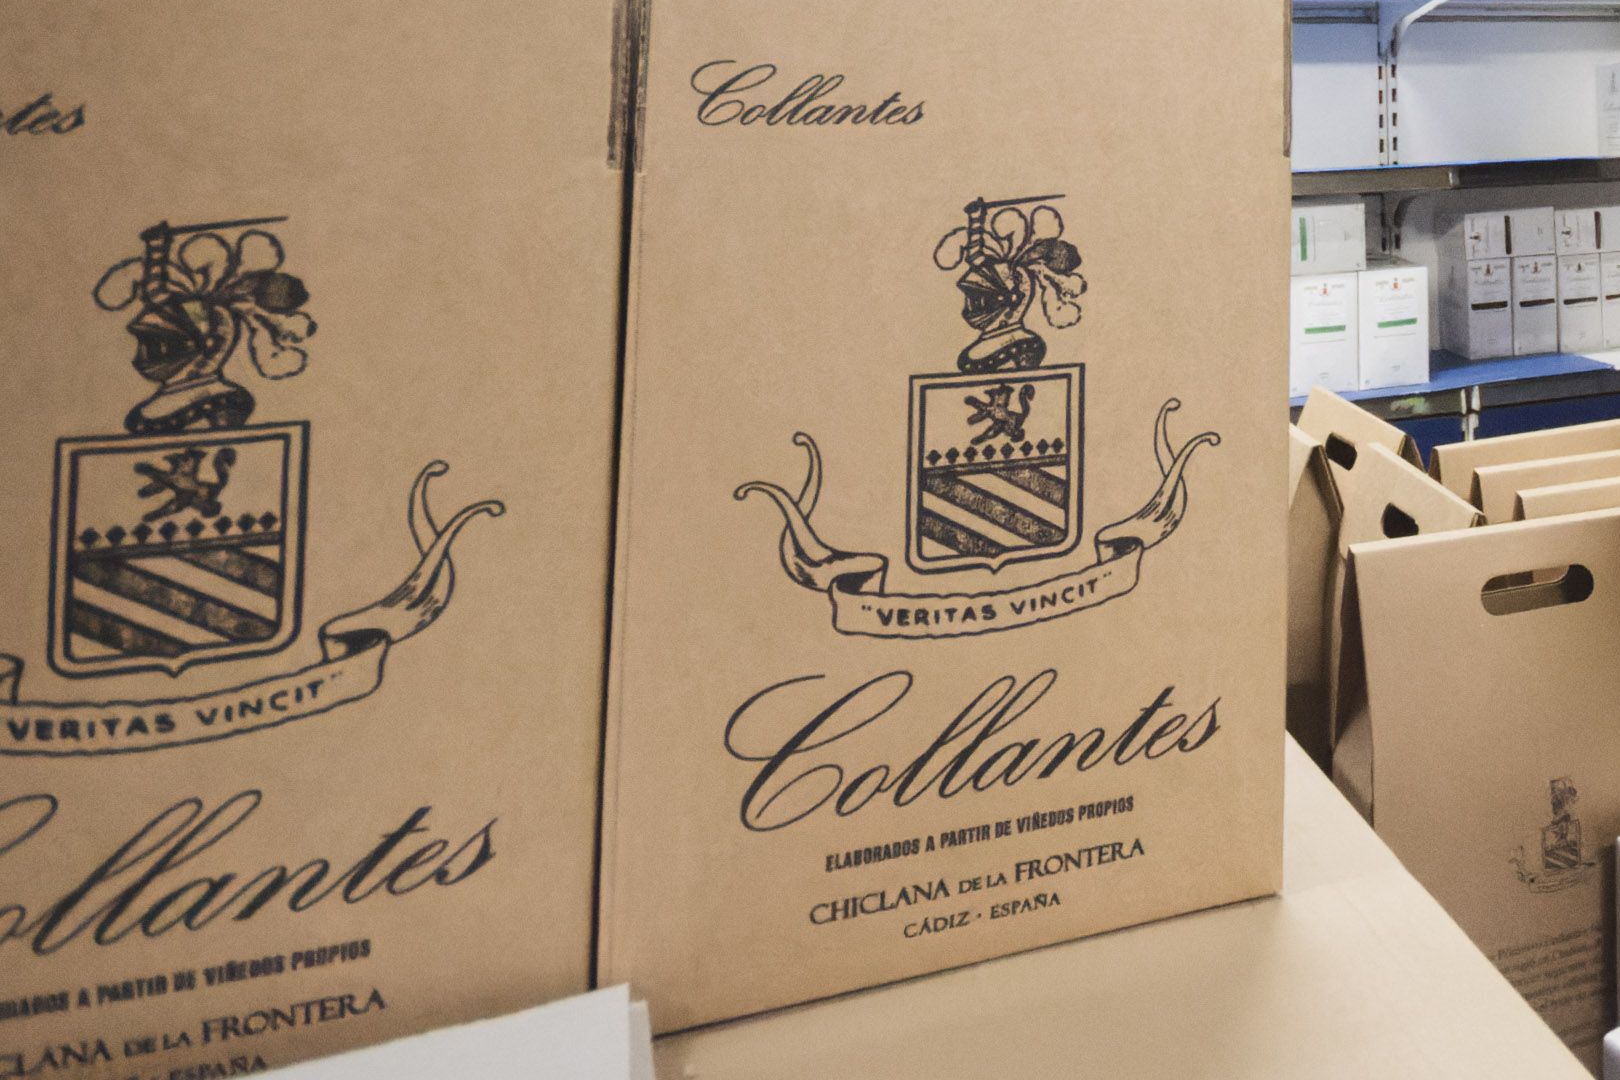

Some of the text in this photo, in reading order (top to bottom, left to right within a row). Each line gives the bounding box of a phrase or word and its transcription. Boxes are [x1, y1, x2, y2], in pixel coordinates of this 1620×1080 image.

[690, 59, 927, 127] Collantes
[724, 668, 1222, 833] Collantes
[825, 794, 1135, 873] ELABORADOS A PARTIR DE VIÑEDOS PROPIOS
[809, 837, 1146, 926] CHICLANA DE LA FRONTERA
[902, 891, 1062, 939] CÁDIZ ESPAÑA
[162, 1030, 191, 1052] LA
[201, 987, 387, 1045] FRONTERA
